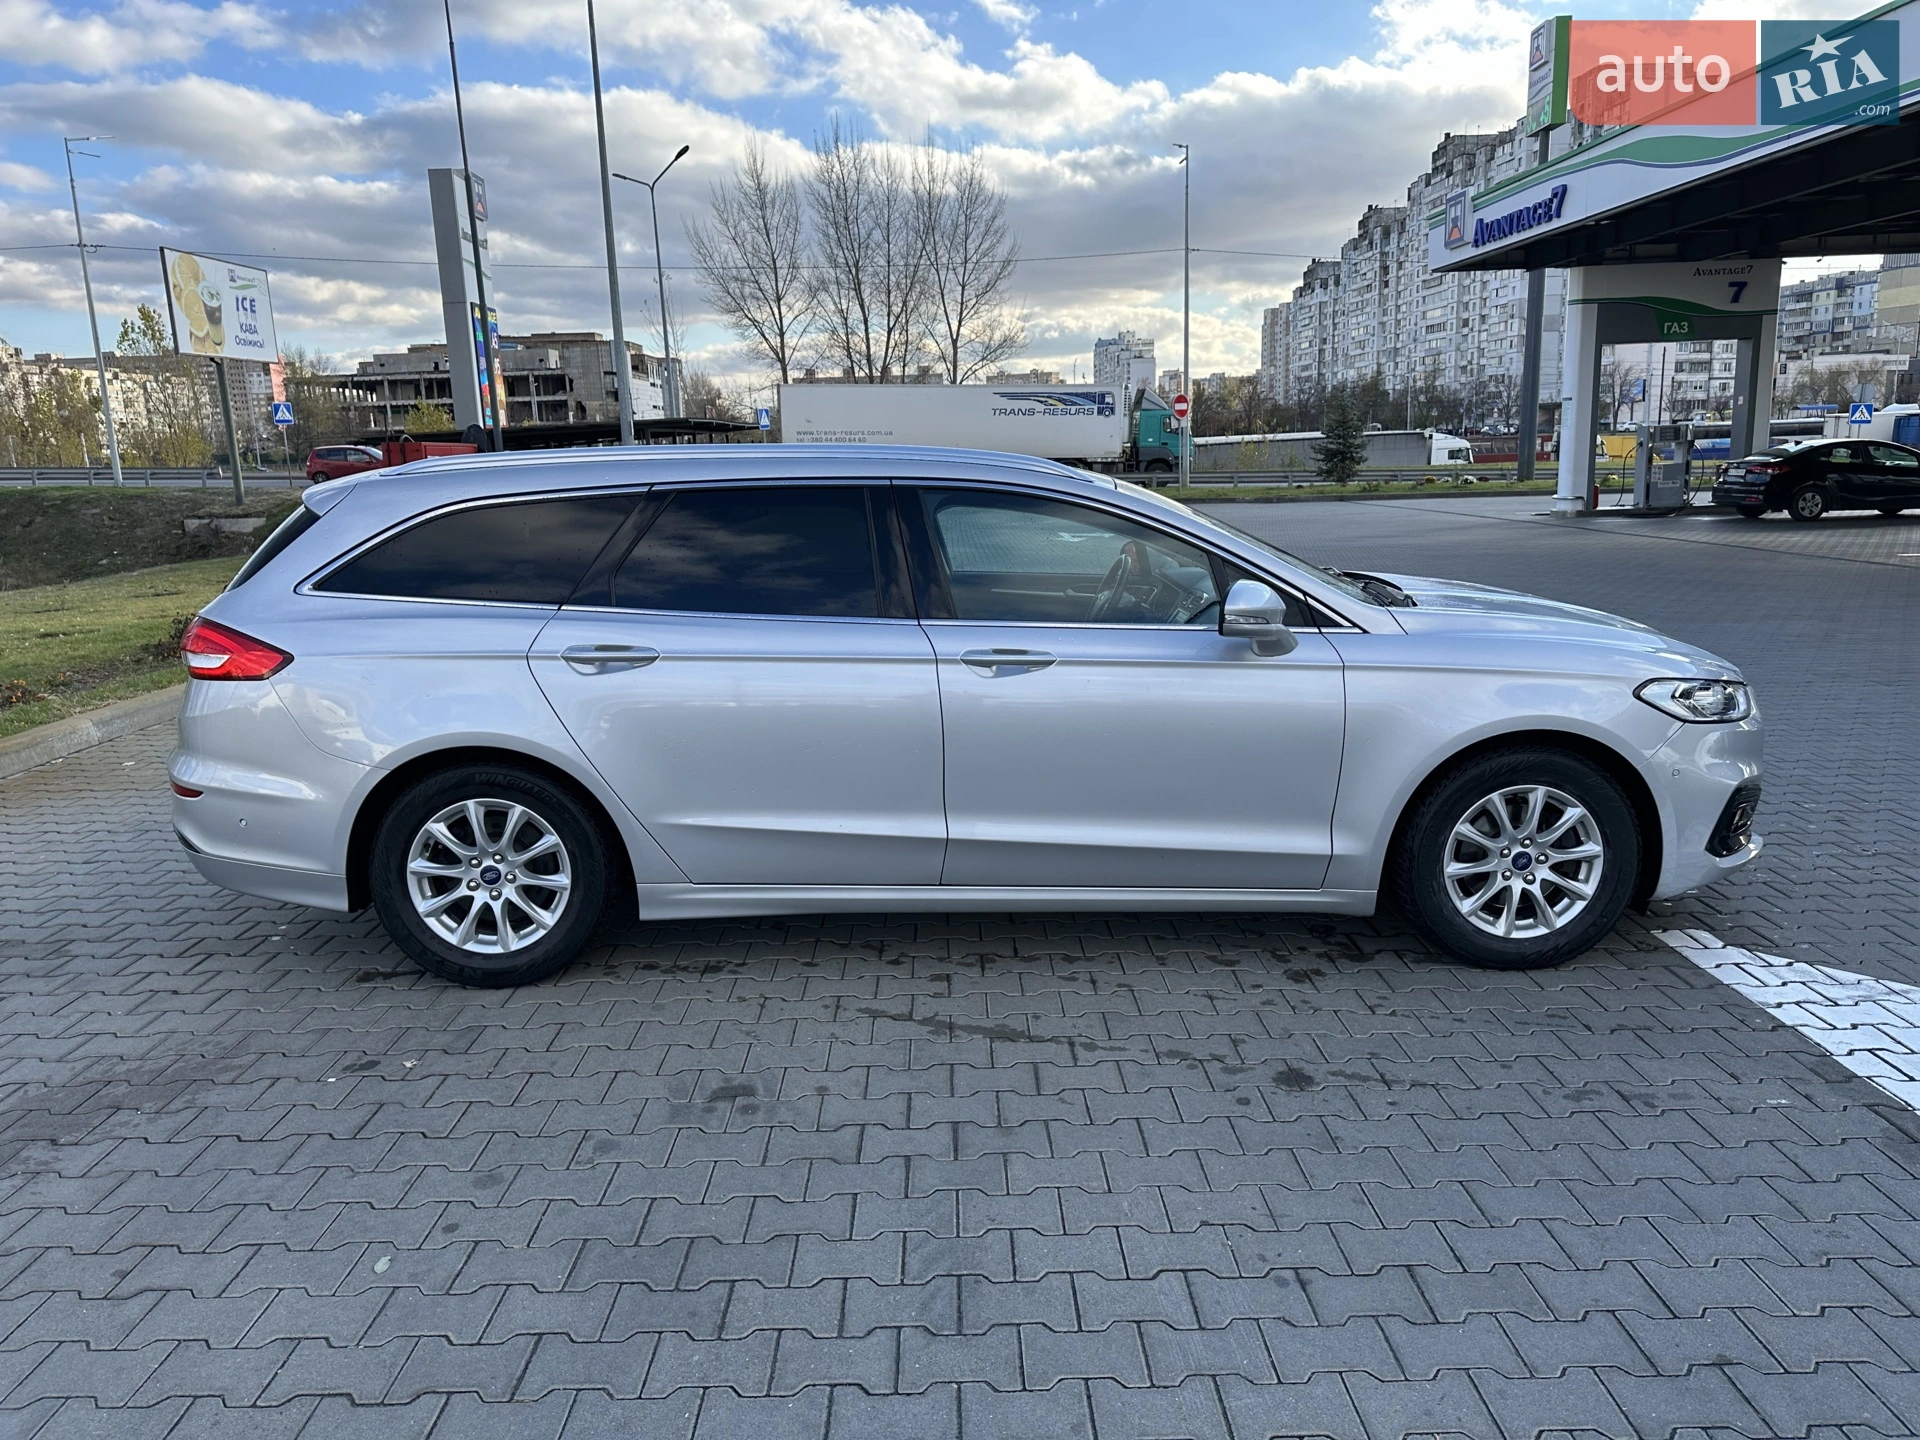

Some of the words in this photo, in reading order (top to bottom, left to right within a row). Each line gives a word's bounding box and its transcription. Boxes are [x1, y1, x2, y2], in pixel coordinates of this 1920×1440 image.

[1728, 281, 1748, 303] 7
[235, 295, 256, 313] ICE
[240, 322, 258, 335] КАВА
[1664, 322, 1688, 334] ГАЗ
[235, 335, 265, 349] Освіжись!
[991, 408, 1094, 416] TRANS-RESURS
